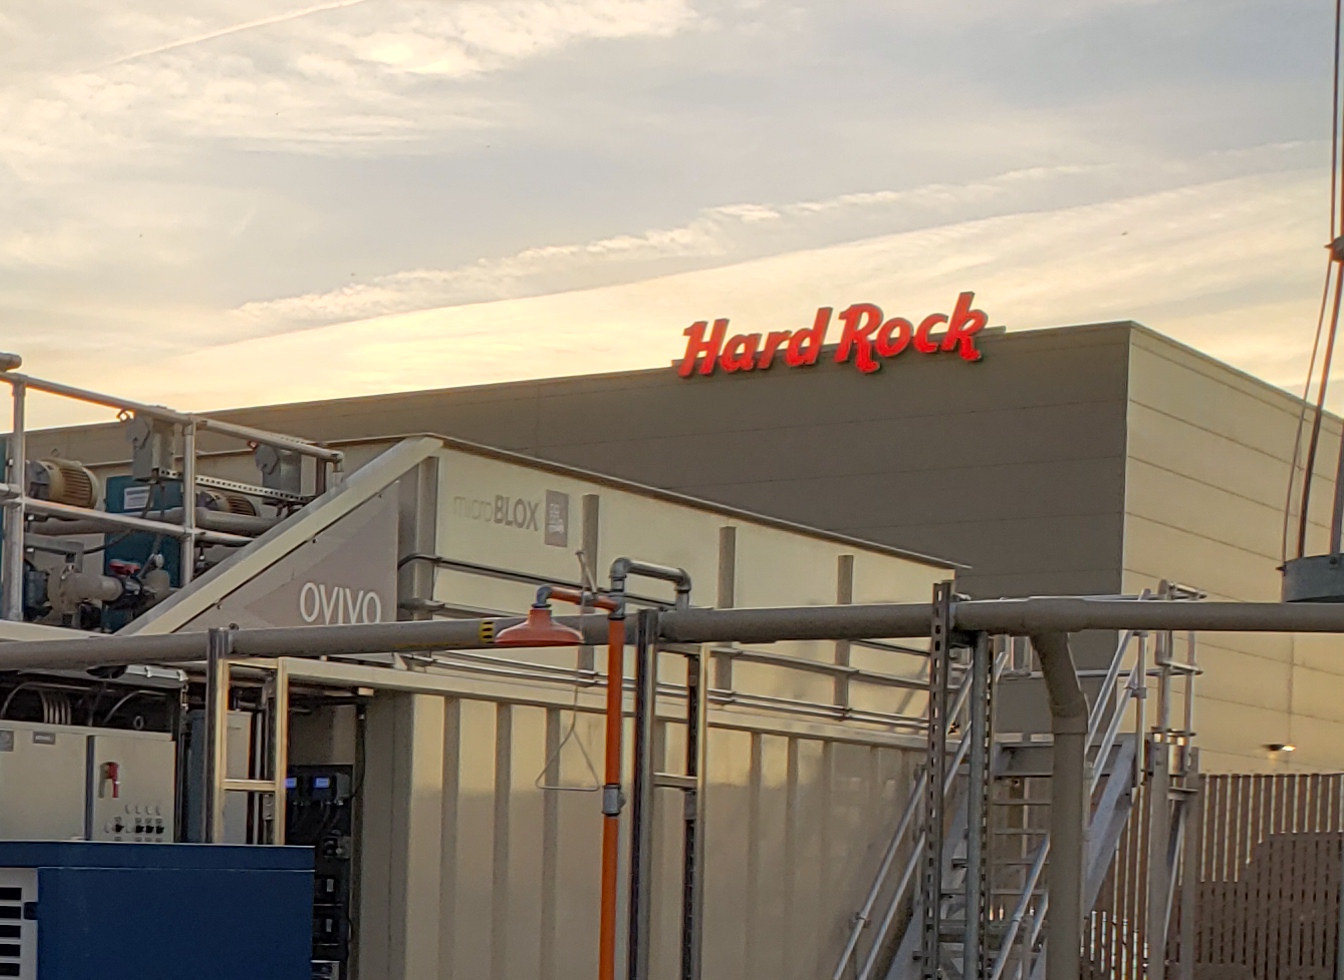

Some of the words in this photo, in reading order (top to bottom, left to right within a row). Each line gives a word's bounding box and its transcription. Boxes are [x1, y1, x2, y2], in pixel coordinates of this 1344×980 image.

[677, 306, 832, 378] Hard
[833, 291, 989, 374] Rock
[300, 582, 381, 625] OVIVO
